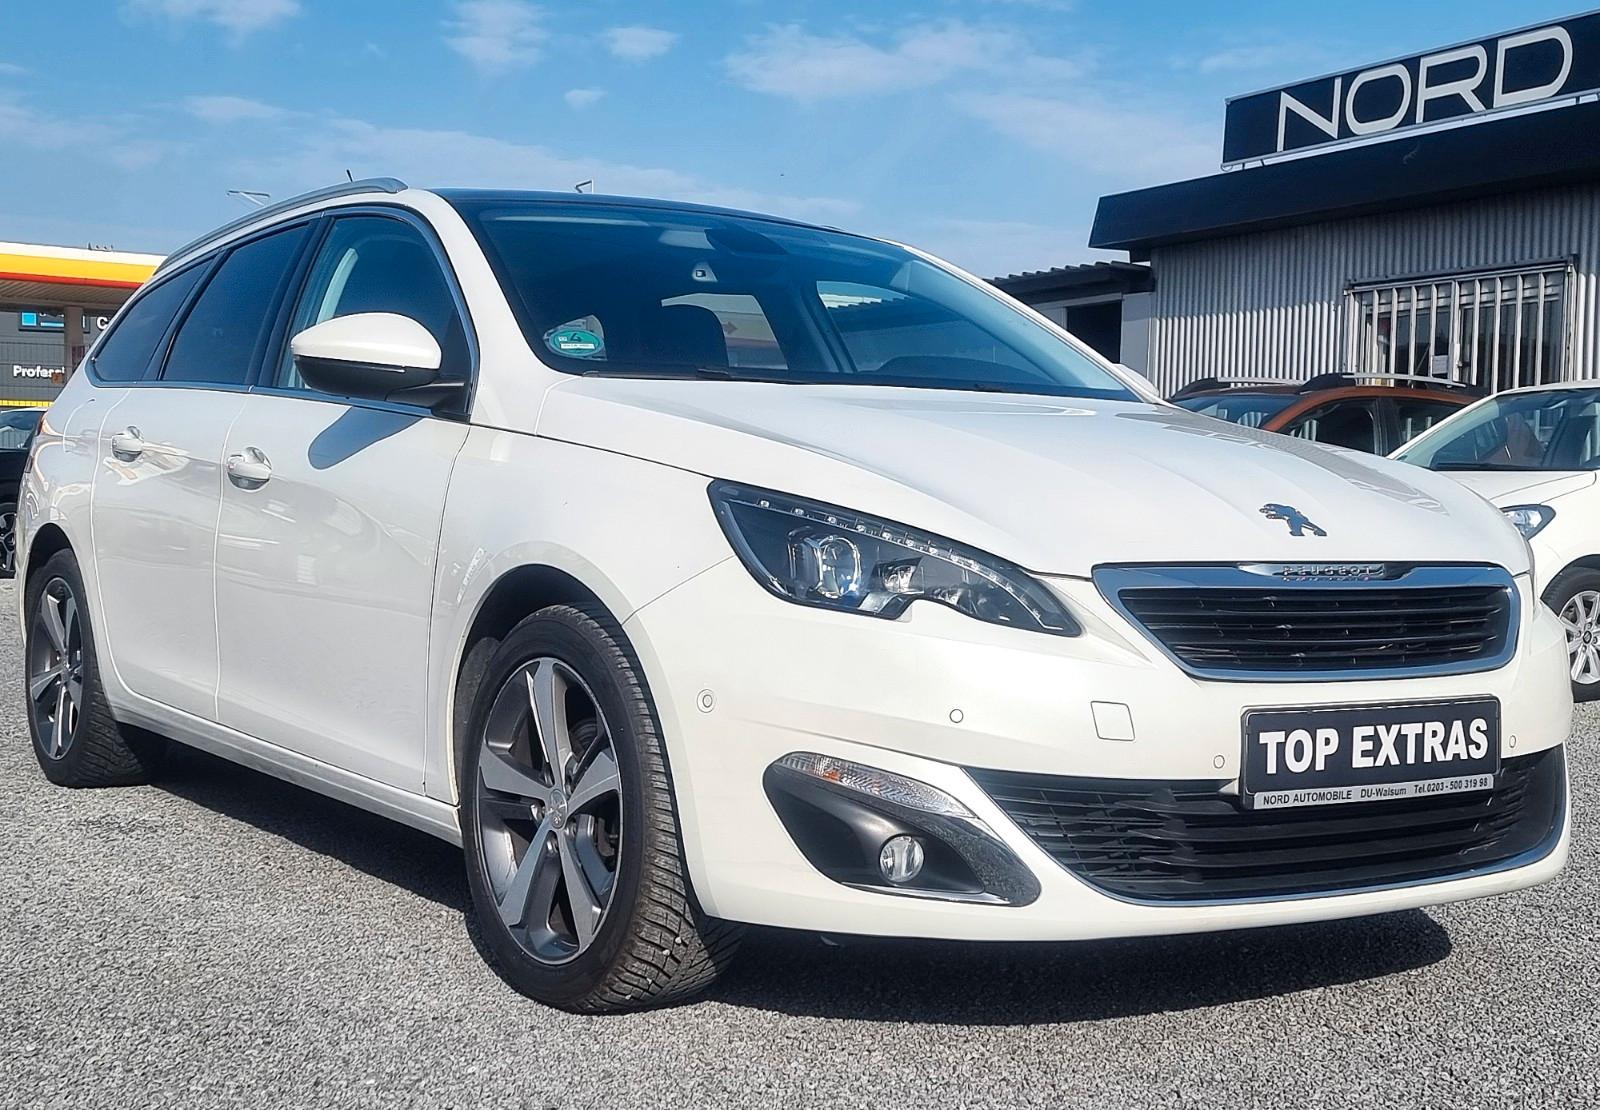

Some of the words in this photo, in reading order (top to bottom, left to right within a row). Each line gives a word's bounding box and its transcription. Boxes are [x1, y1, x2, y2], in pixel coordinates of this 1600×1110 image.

[1276, 25, 1574, 153] NORD
[1282, 565, 1372, 576] PEUGEOT
[1259, 728, 1339, 774] TOP
[1351, 717, 1489, 769] EXTRAS
[1263, 794, 1291, 806] NORD
[1292, 789, 1353, 804] AUTOMOBILE
[1360, 786, 1406, 798] DU-Walsum
[1449, 780, 1463, 790] 500
[1464, 778, 1478, 789] 319
